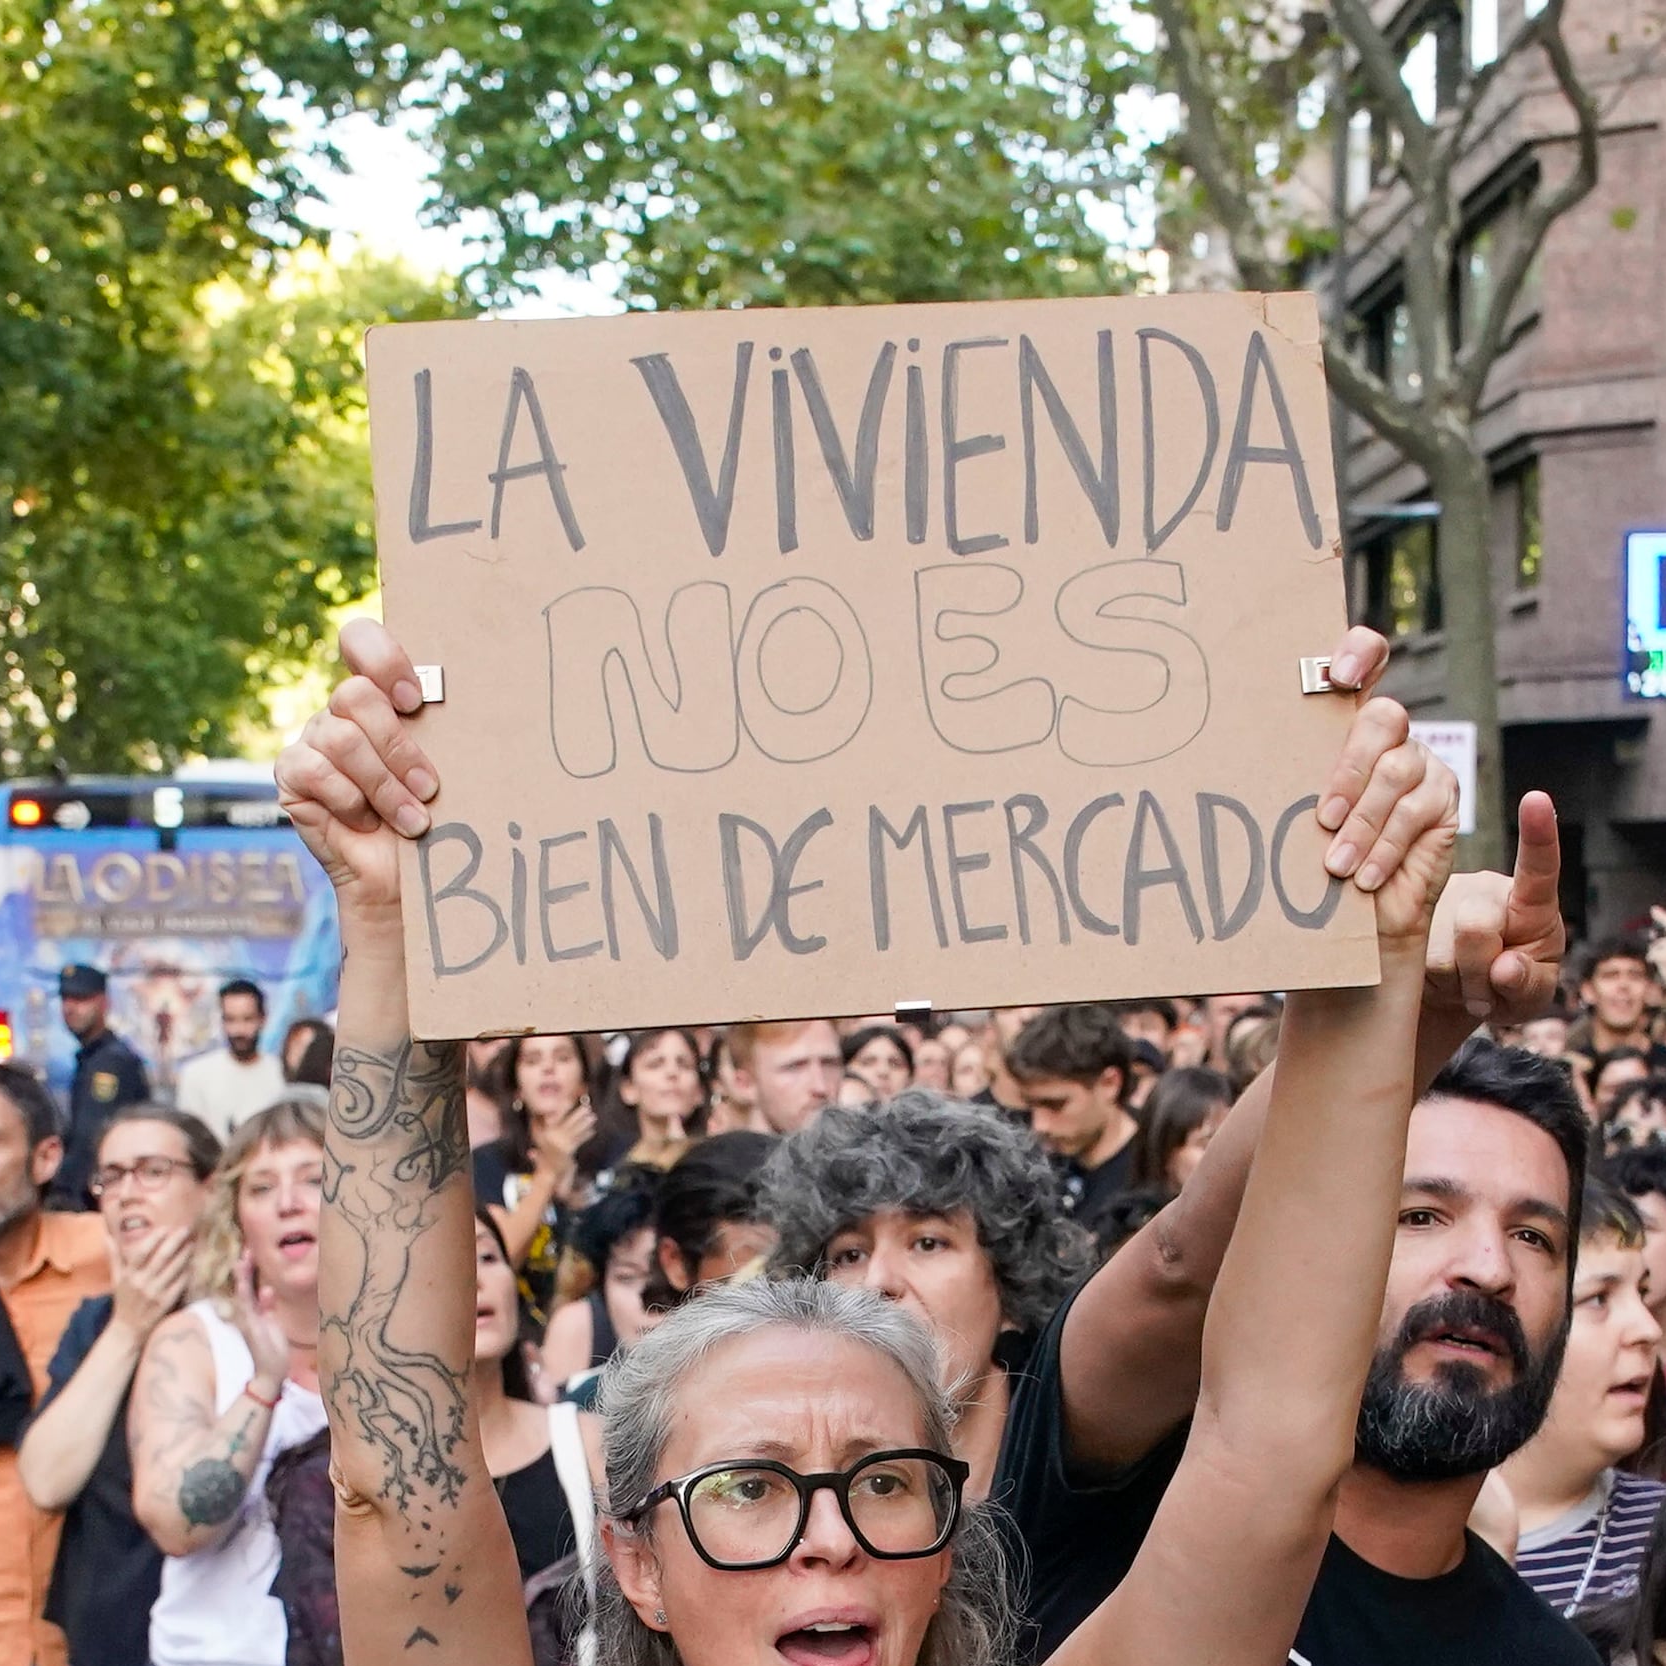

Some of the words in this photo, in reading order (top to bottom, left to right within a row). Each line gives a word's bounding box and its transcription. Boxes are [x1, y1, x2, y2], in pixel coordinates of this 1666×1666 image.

[408, 365, 586, 552] LA
[542, 575, 874, 778] NO
[915, 559, 1210, 767] ES
[93, 852, 307, 904] ODISEA
[720, 806, 835, 962] DE
[869, 790, 1345, 953] MERCADO
